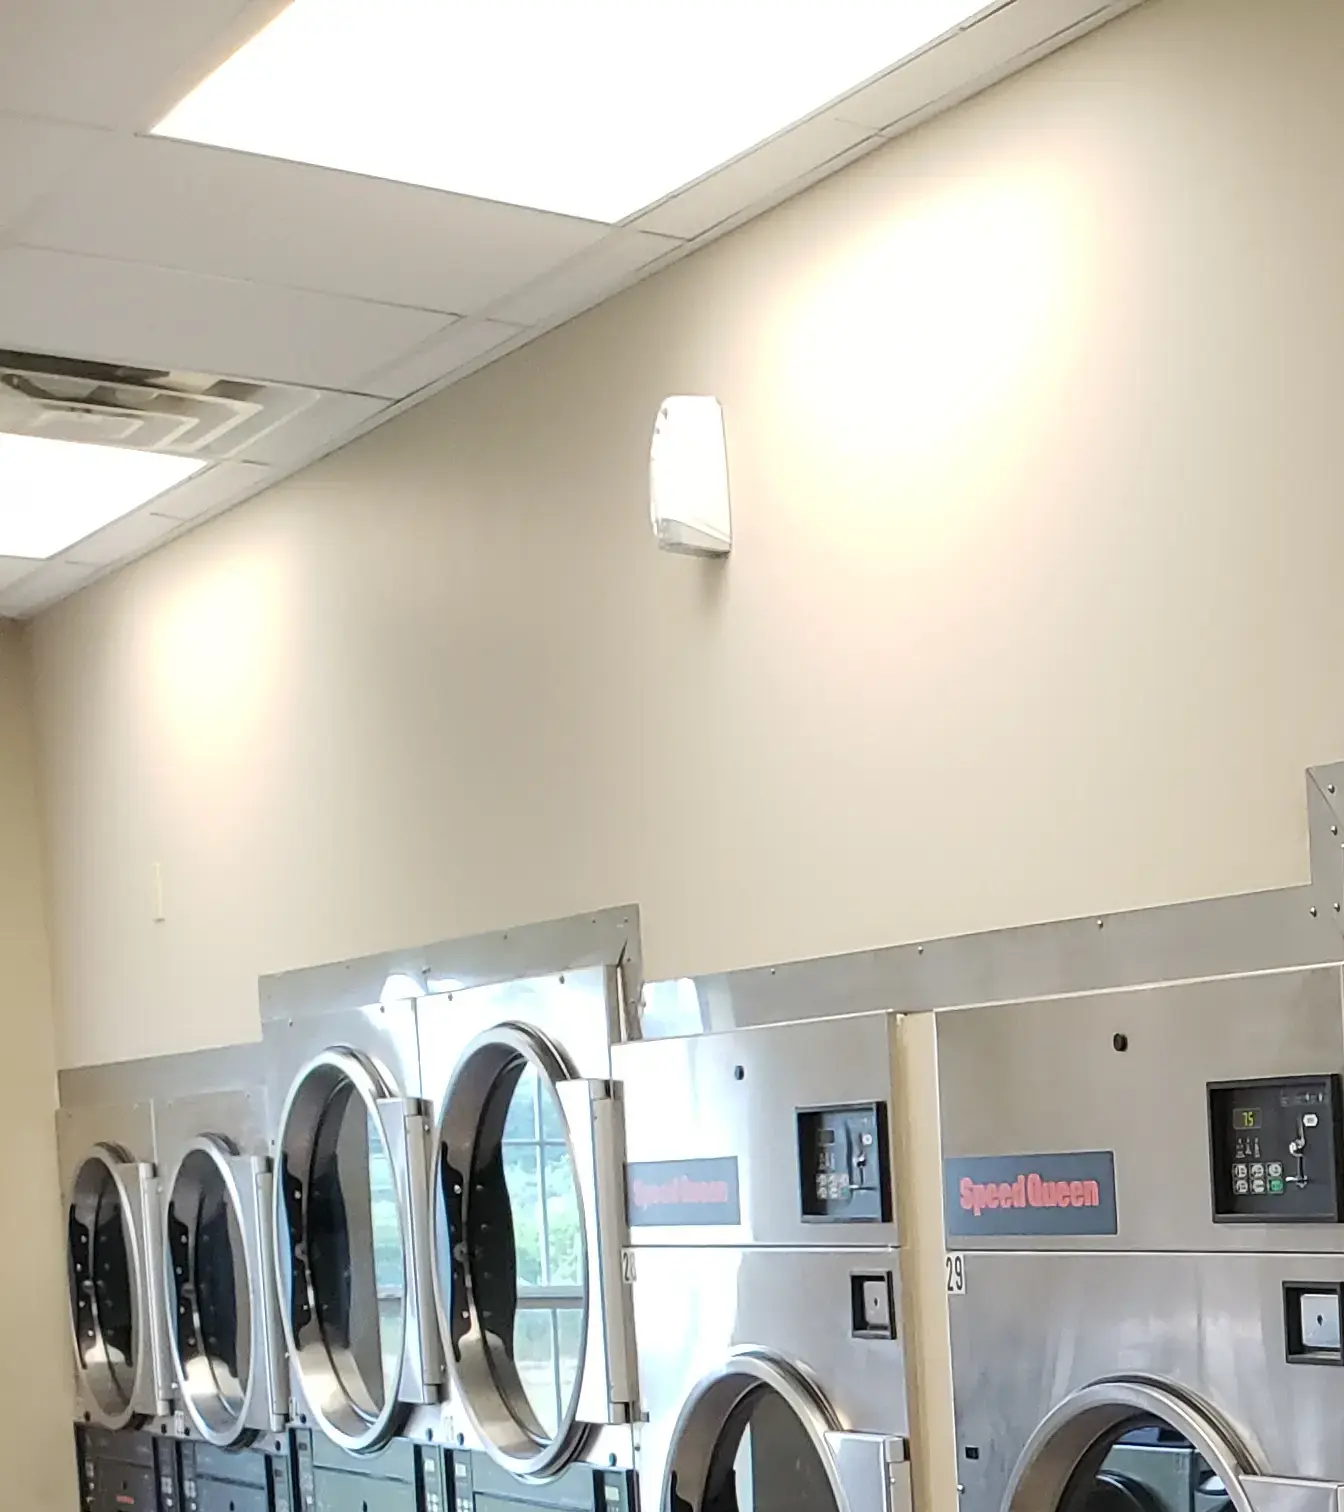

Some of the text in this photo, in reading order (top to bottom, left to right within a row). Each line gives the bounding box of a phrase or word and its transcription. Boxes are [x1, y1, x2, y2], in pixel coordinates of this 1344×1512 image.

[960, 1173, 1099, 1216] Speed Queen
[946, 1255, 963, 1292] 29
